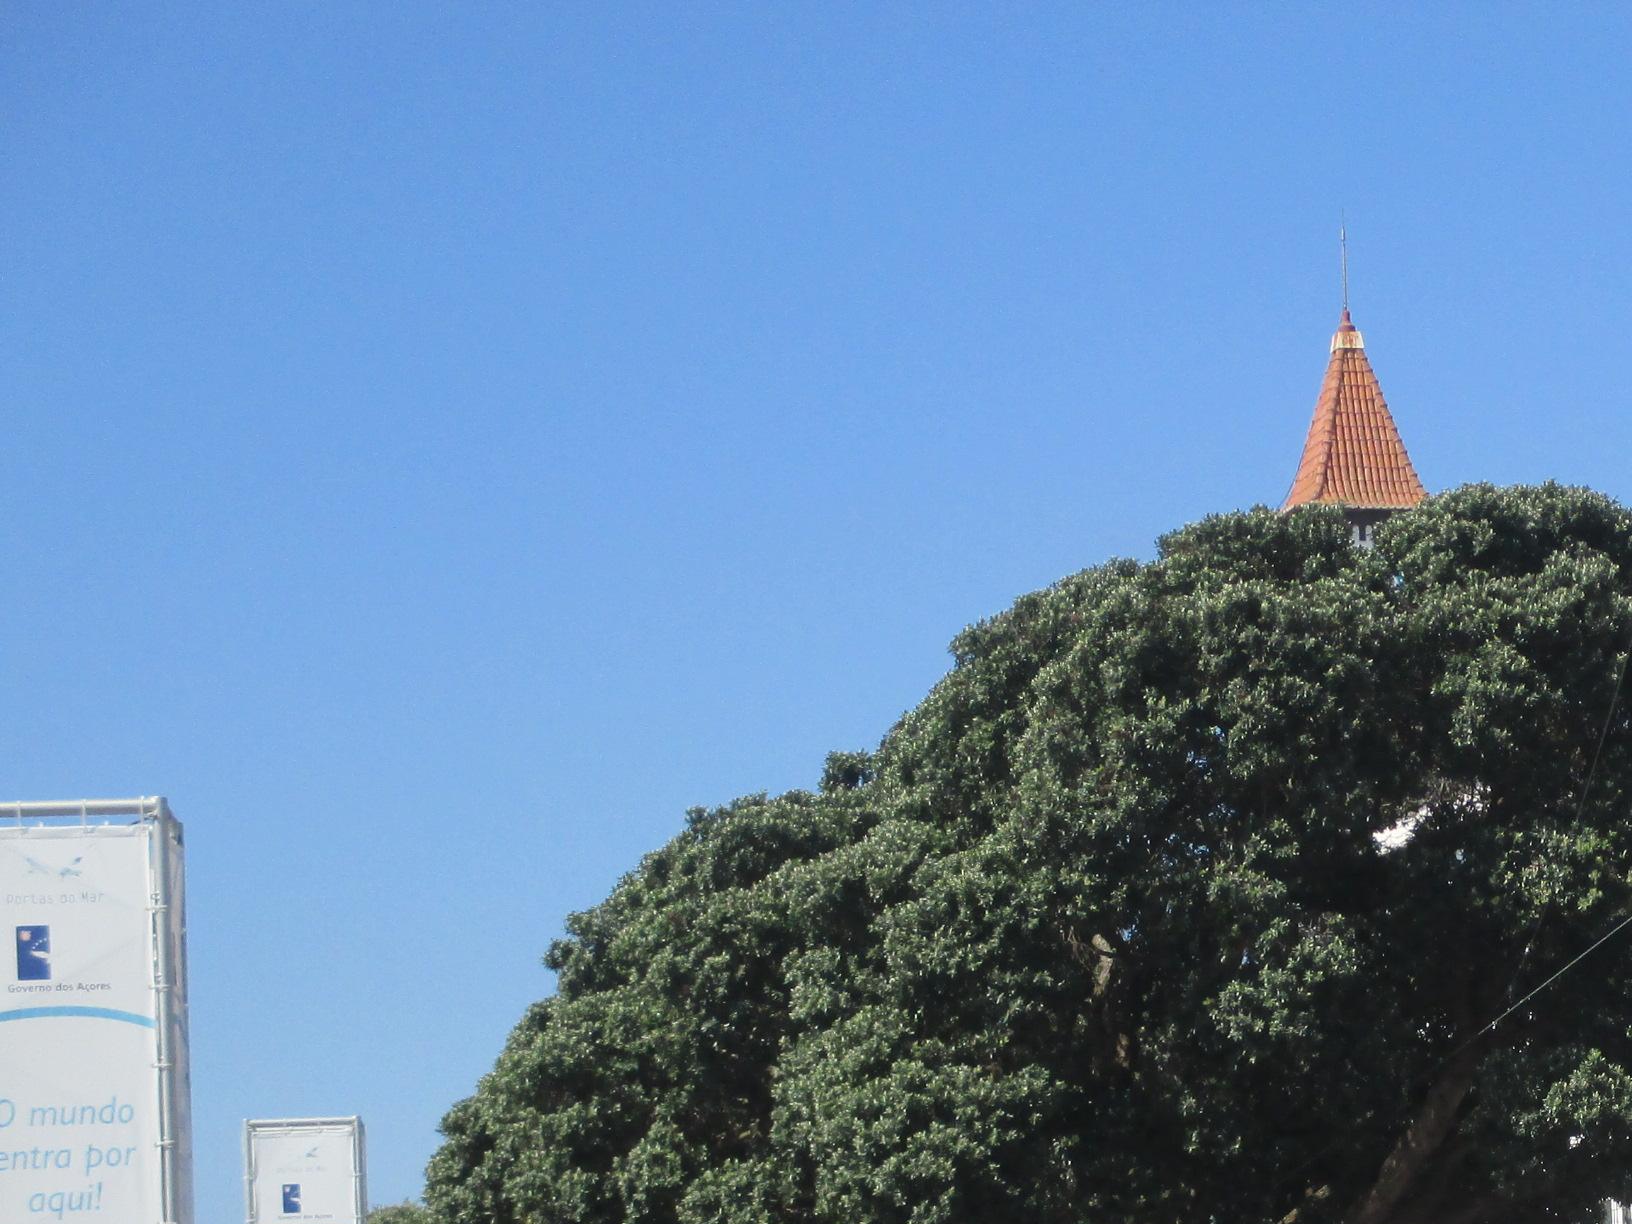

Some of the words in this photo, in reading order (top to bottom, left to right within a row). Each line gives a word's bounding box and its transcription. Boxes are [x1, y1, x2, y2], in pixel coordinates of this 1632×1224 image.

[7, 984, 52, 993] Governo
[55, 983, 74, 991] dos
[77, 982, 112, 993] Açores
[29, 1095, 135, 1127] mundo
[86, 1144, 136, 1176] por
[29, 1182, 103, 1220] aqui!
